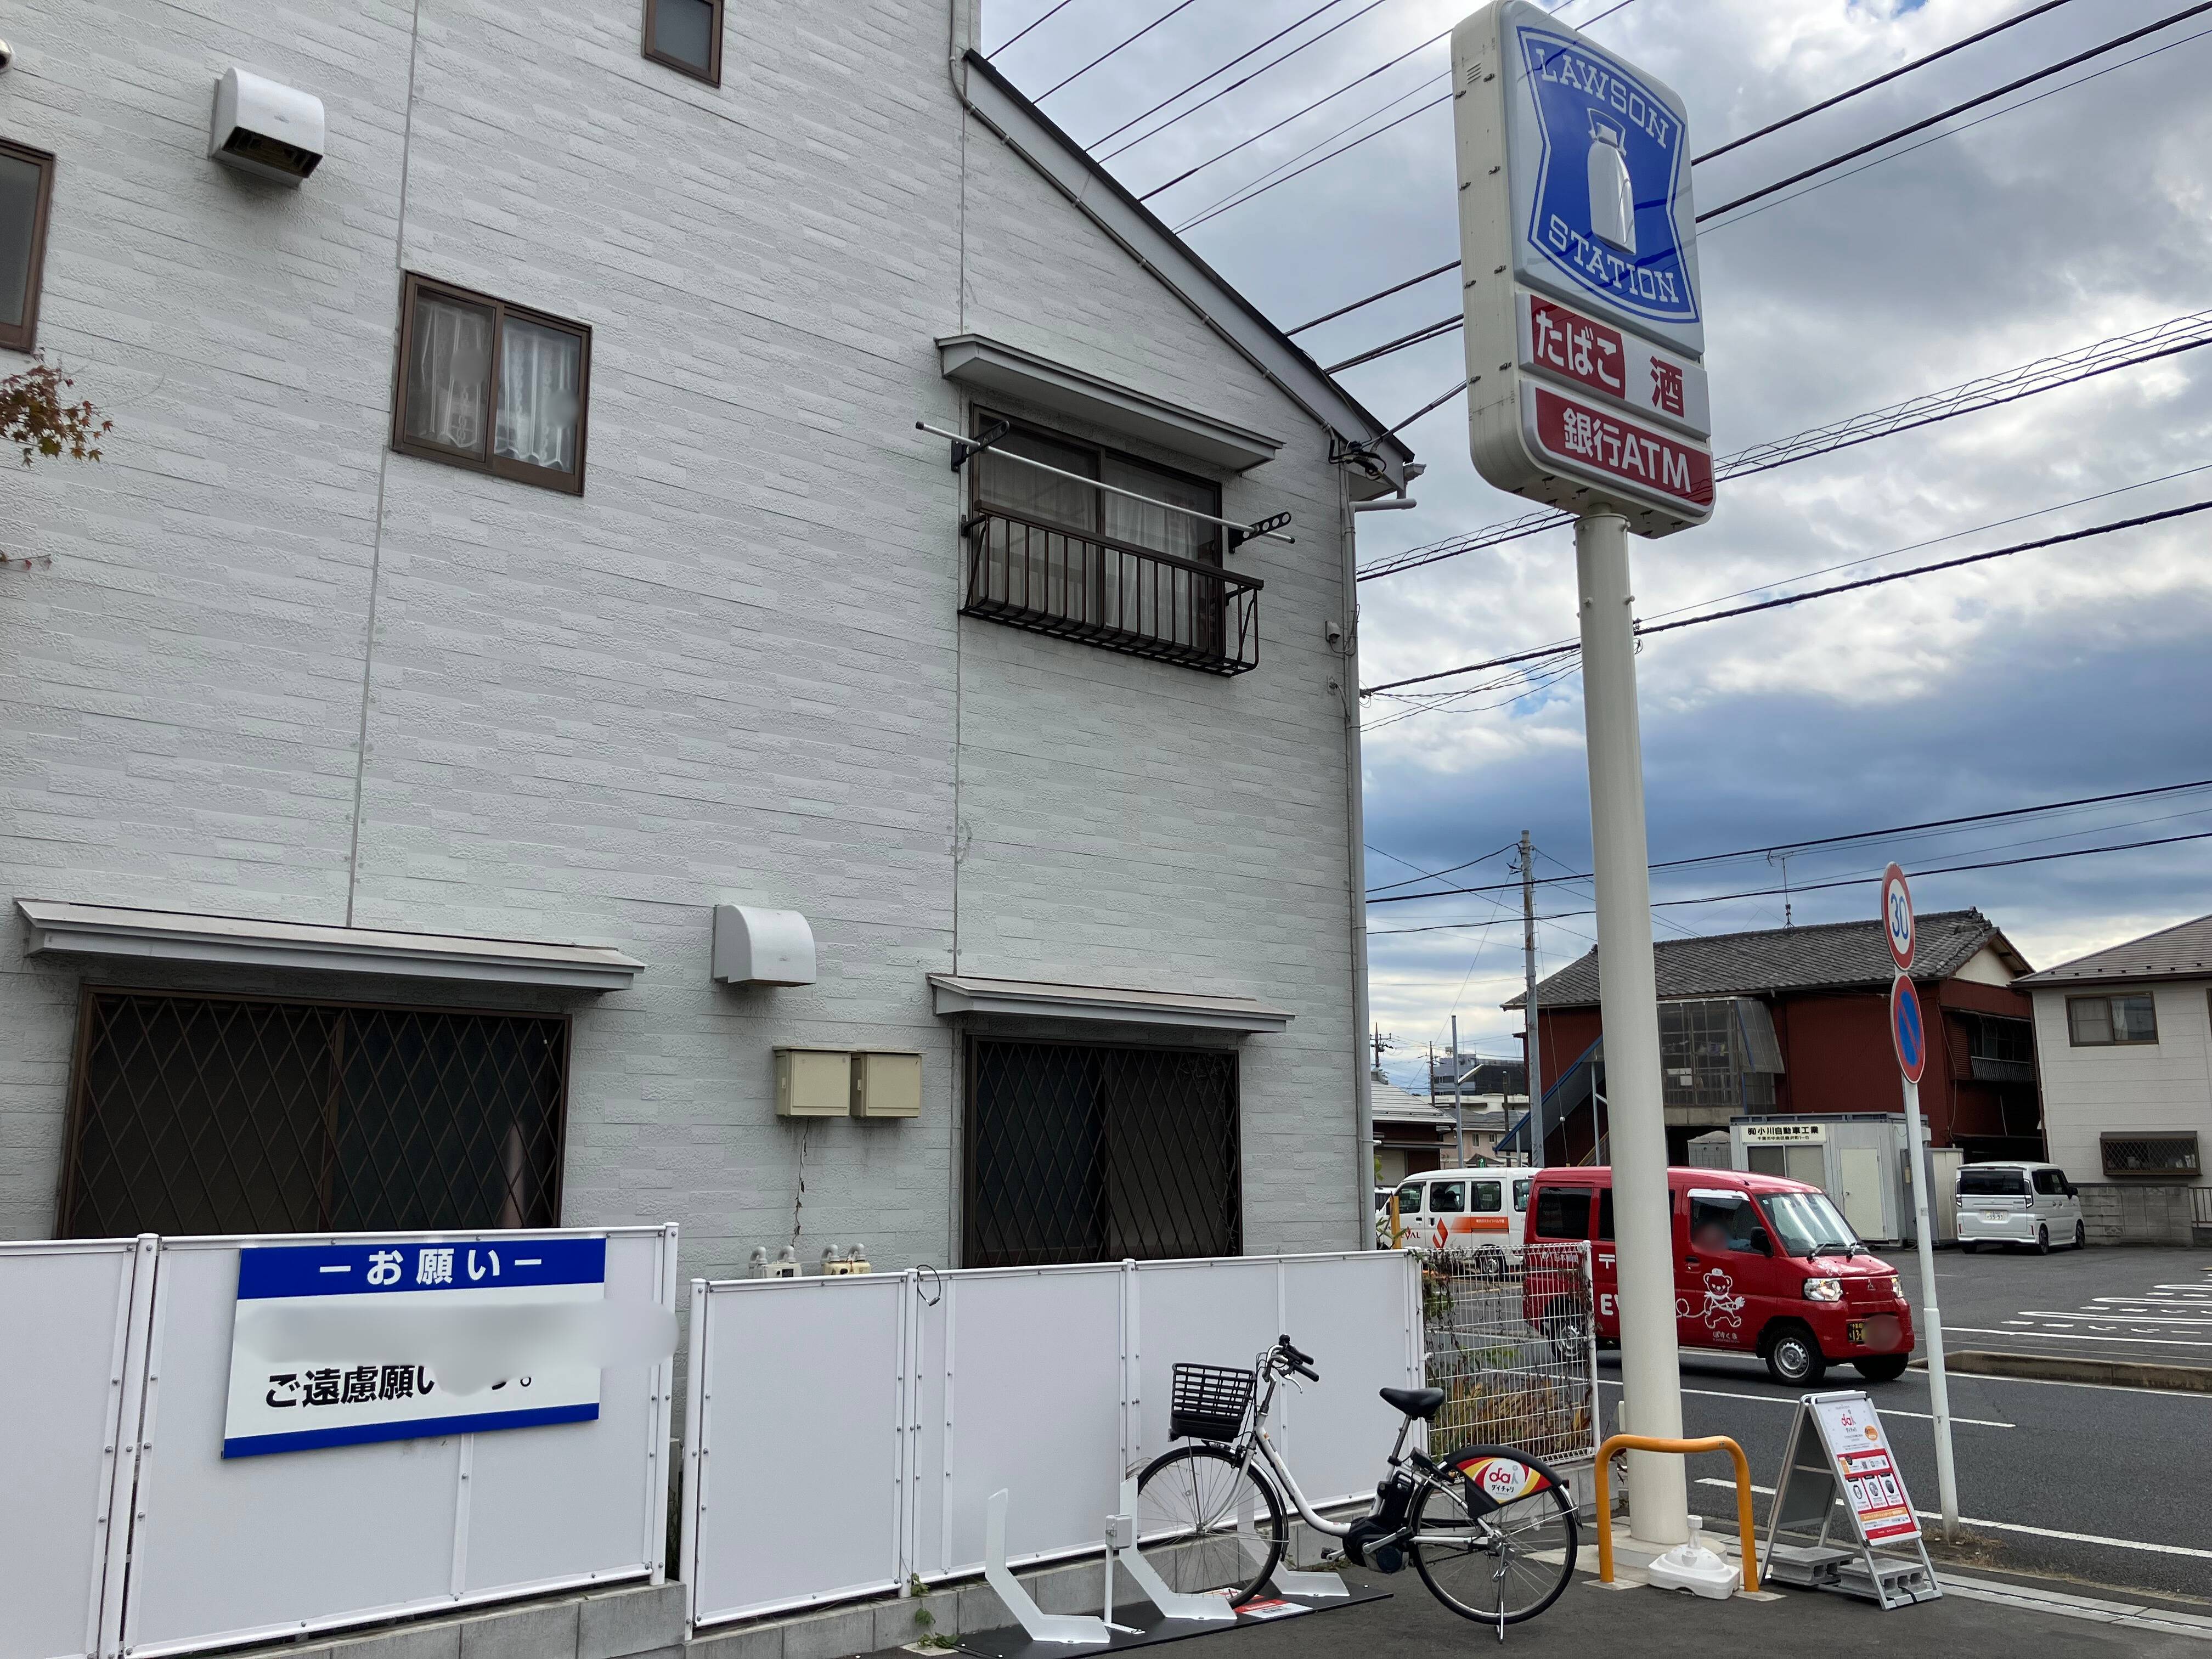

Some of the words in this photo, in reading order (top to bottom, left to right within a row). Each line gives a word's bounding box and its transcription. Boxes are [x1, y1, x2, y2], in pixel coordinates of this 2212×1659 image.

[1536, 48, 1669, 149] LAWSON
[1549, 213, 1679, 303] STATION
[1536, 310, 1621, 389] たばこ
[1650, 355, 1684, 418] 酒
[1562, 407, 1691, 493] 銀行ATM
[1891, 893, 1909, 940] 30
[1491, 1484, 1515, 1493] ダイチャリ
